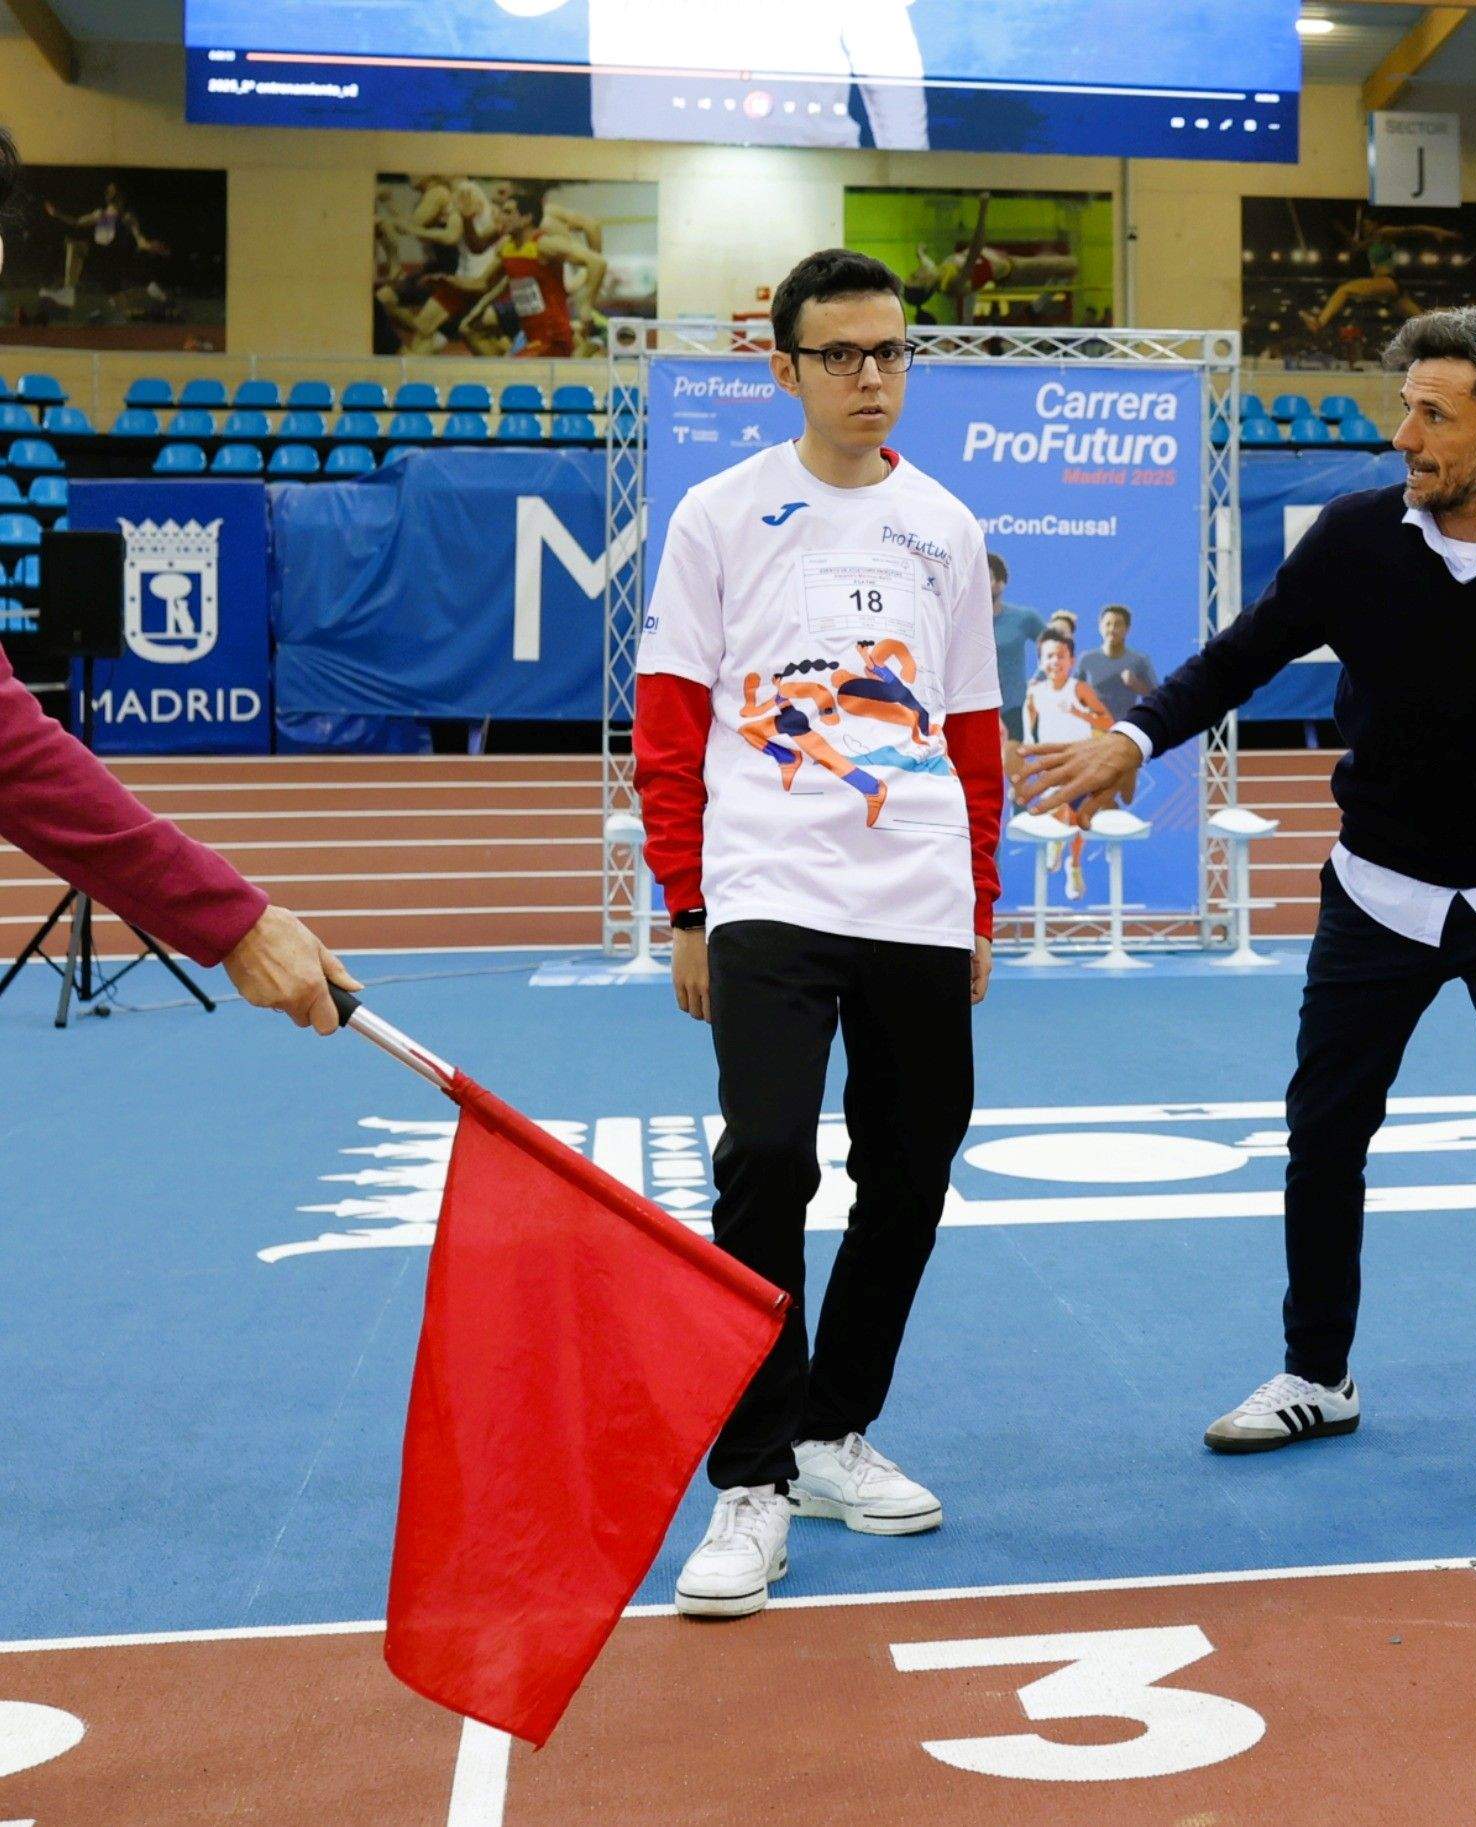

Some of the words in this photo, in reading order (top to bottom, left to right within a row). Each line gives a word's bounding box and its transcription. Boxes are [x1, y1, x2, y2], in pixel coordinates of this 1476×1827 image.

[1411, 147, 1424, 198] J
[673, 376, 776, 399] ProFuturo
[1035, 382, 1178, 421] Carrera
[962, 422, 1178, 465] ProFuturo
[1062, 468, 1126, 487] Madrid
[1131, 469, 1177, 487] 2025
[850, 589, 883, 613] 18
[79, 687, 261, 723] MADRID
[890, 1624, 1267, 1781] 3
